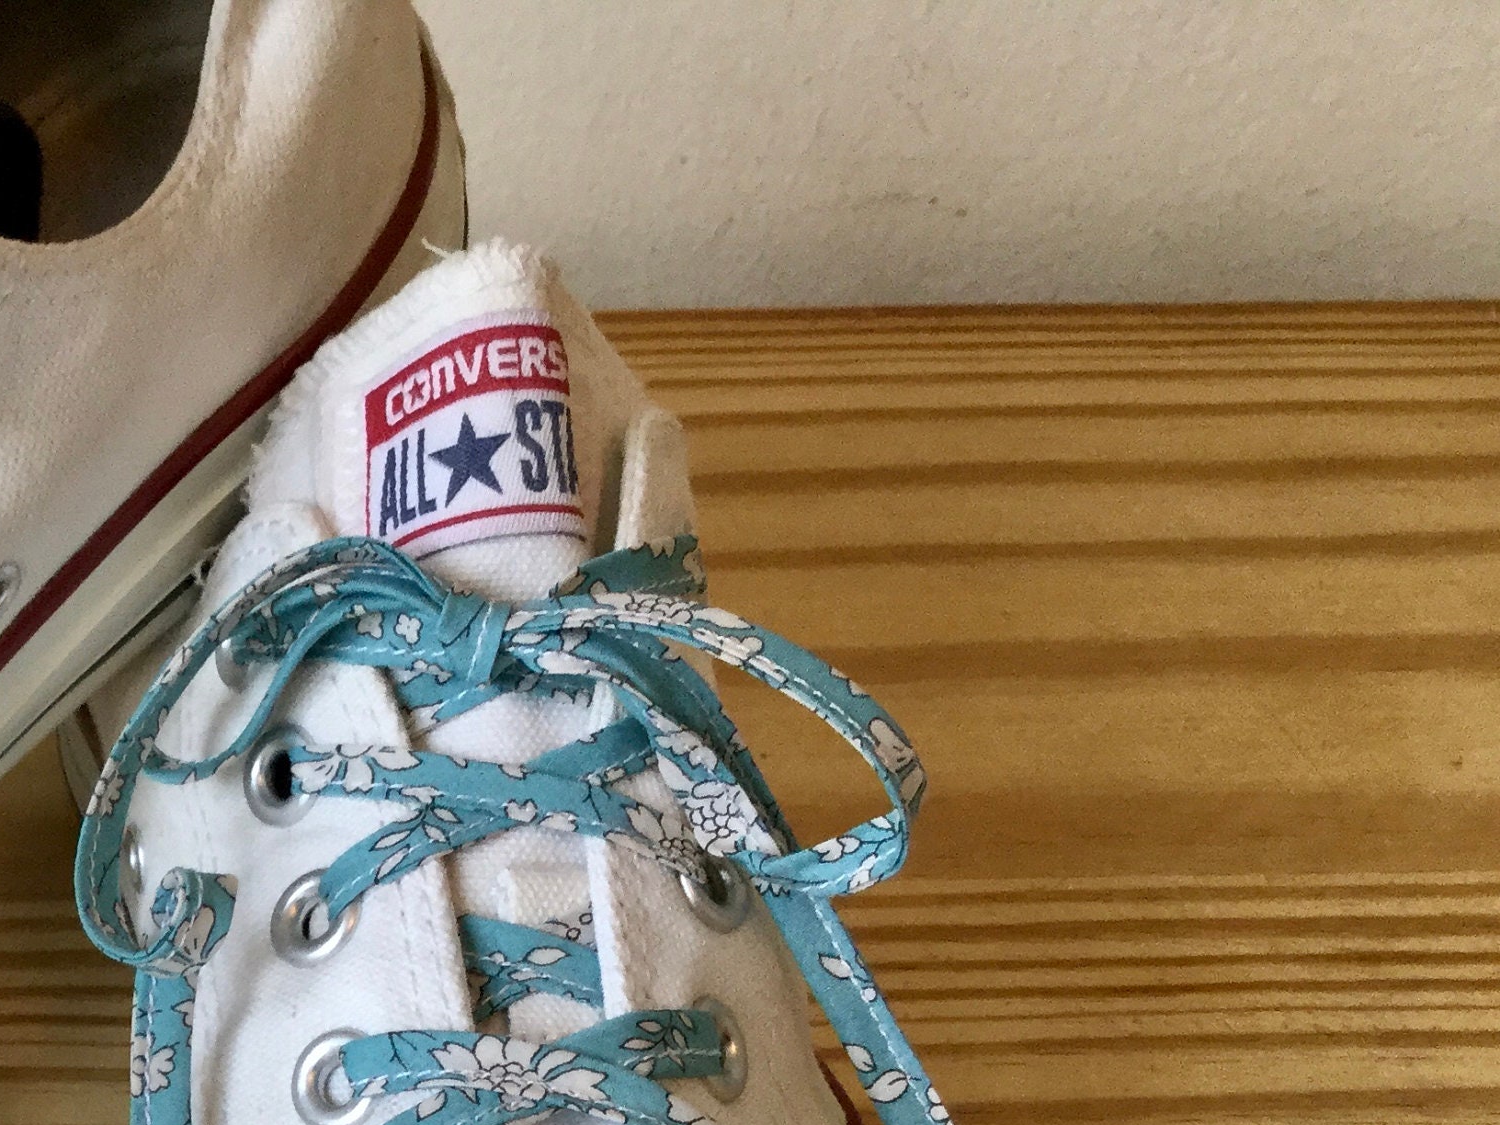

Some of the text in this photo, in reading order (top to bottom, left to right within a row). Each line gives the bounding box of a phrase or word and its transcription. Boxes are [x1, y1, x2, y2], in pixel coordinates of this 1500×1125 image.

[386, 336, 568, 426] CONVERS
[379, 399, 579, 537] ALL ST
